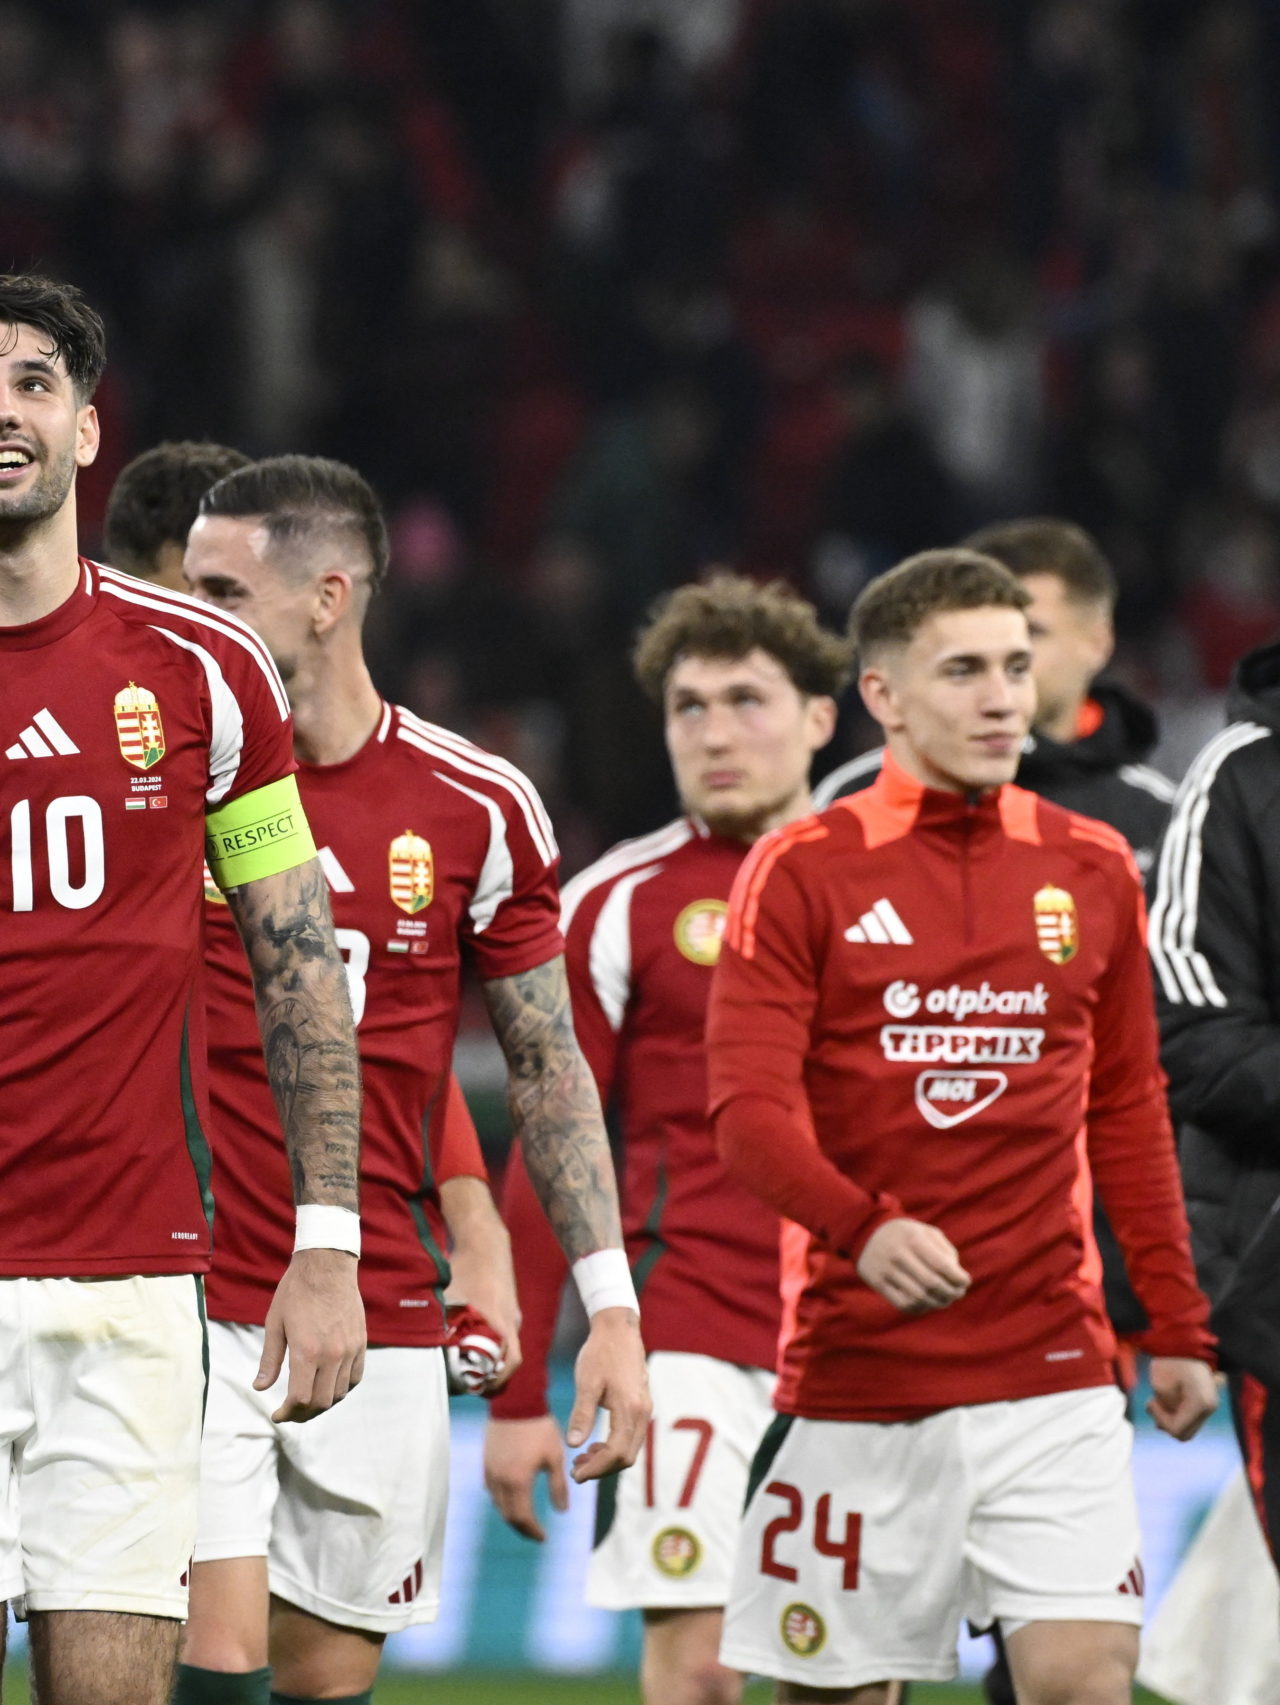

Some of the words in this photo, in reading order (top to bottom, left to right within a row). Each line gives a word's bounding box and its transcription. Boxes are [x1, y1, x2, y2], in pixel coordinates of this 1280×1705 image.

[131, 784, 162, 792] BUDAPEST
[11, 795, 105, 912] 10
[222, 815, 295, 852] RESPECT
[925, 981, 1048, 1021] otpbank
[646, 1418, 715, 1508] 17
[760, 1481, 863, 1591] 24
